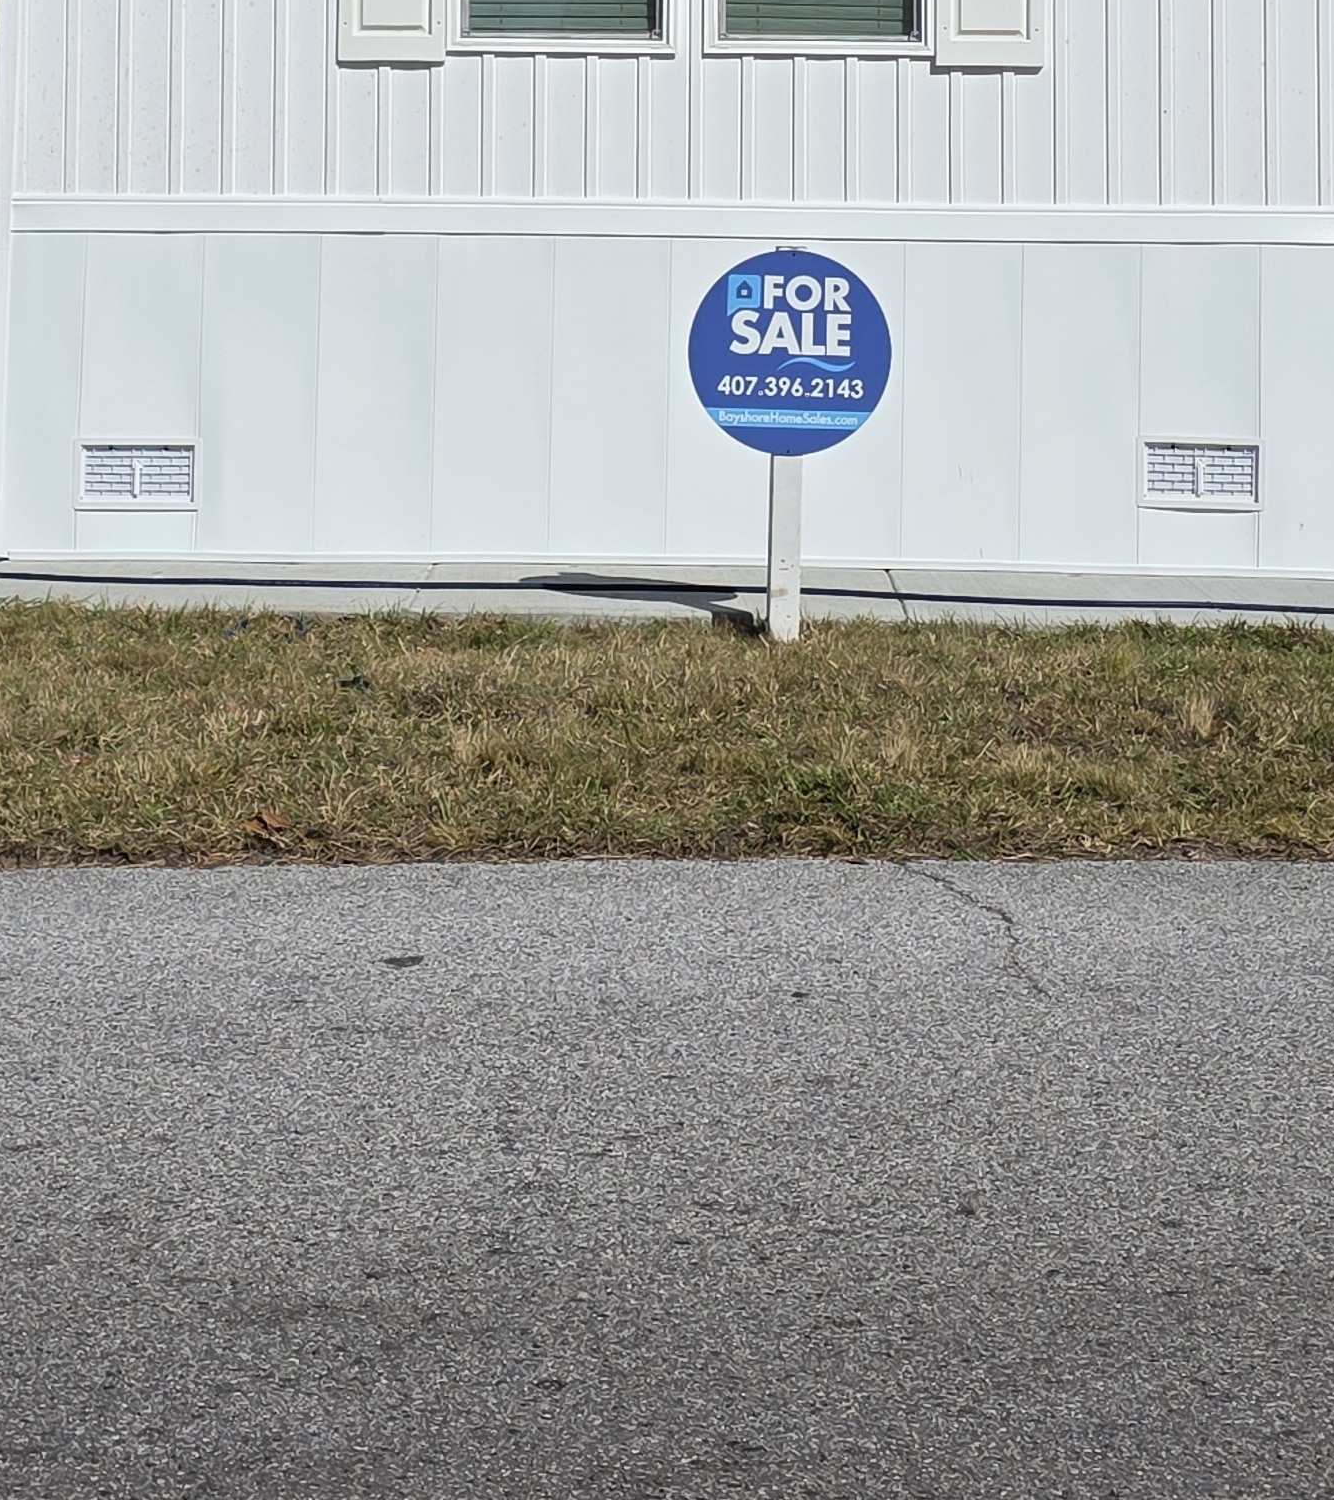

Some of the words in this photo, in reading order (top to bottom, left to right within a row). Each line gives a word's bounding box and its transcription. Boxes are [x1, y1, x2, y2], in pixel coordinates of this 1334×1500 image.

[763, 275, 851, 311] FOR
[729, 310, 851, 357] SALE
[717, 375, 864, 399] 407.396.2143
